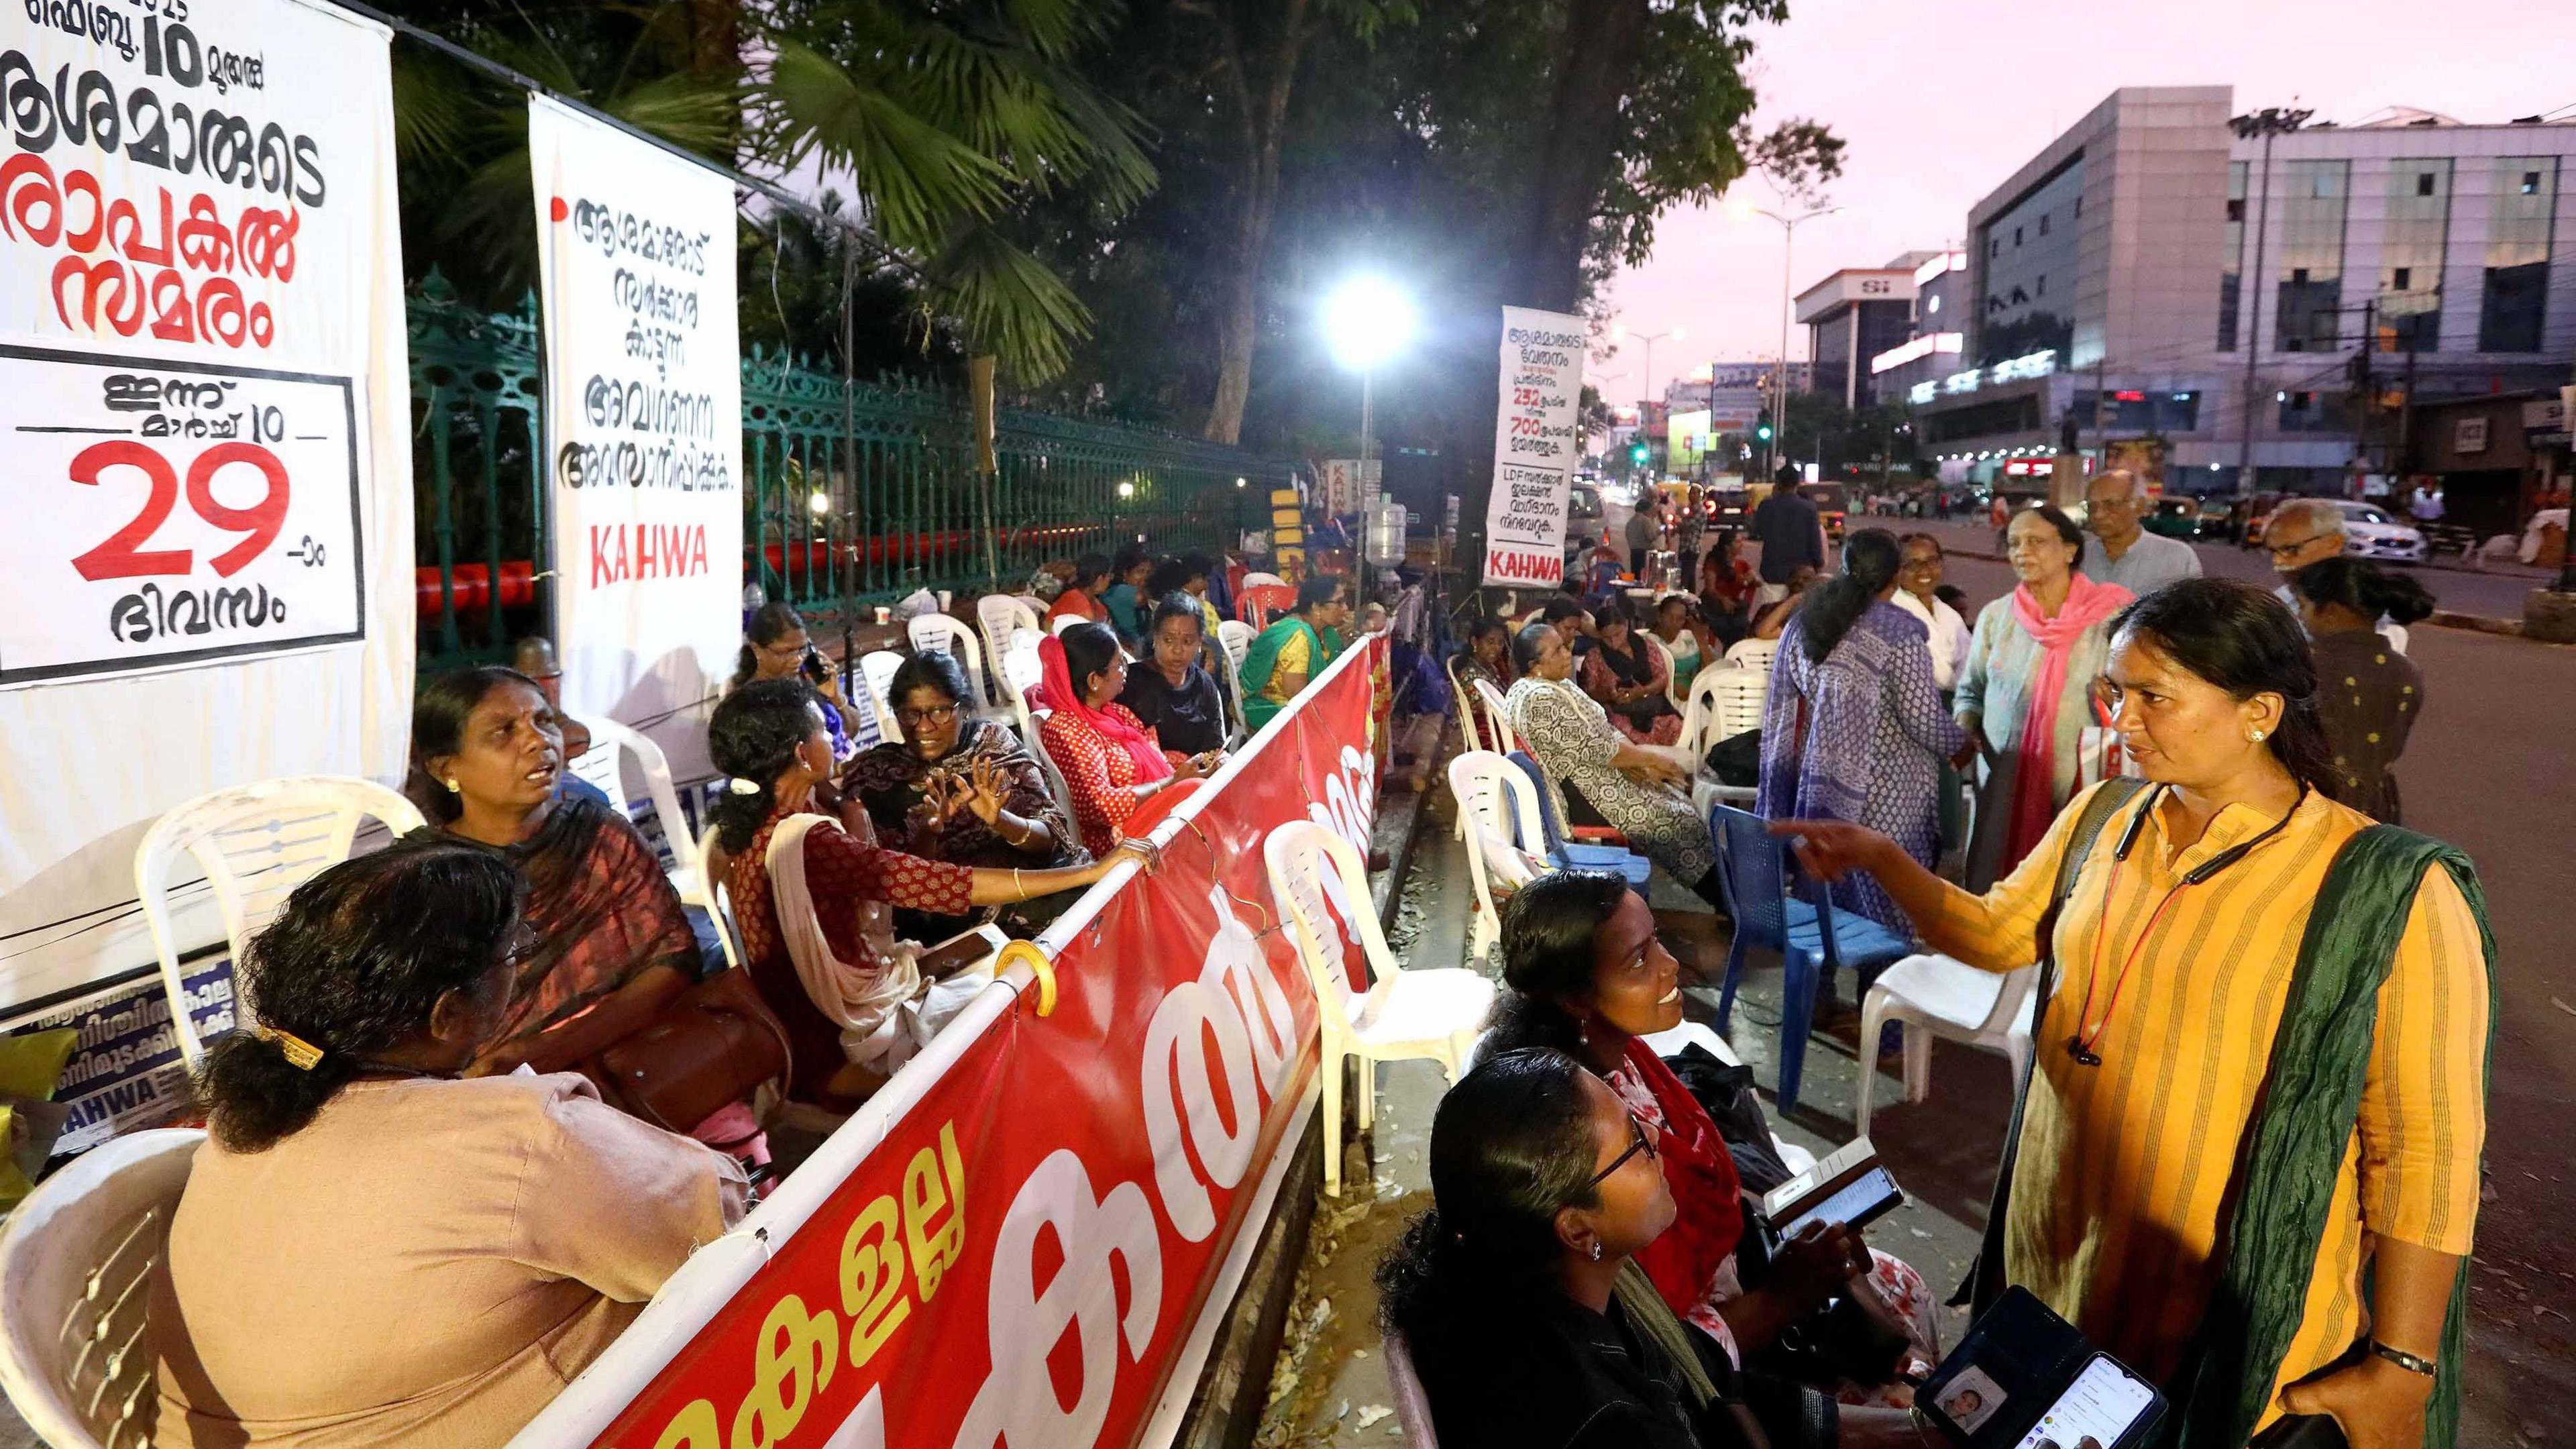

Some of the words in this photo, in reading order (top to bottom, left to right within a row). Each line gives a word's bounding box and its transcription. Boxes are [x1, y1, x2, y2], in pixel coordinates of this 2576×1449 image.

[144, 15, 203, 87] 10
[52, 255, 274, 348] സമരം
[252, 404, 284, 444] 10
[1511, 417, 1540, 435] 700
[1514, 388, 1540, 406] 232
[1504, 470, 1523, 481] LDF
[69, 439, 290, 582] 29
[590, 523, 708, 590] KAHWA
[1491, 550, 1562, 582] KAHWA
[110, 582, 286, 643] ദിവസം
[63, 1077, 158, 1135] AHWA
